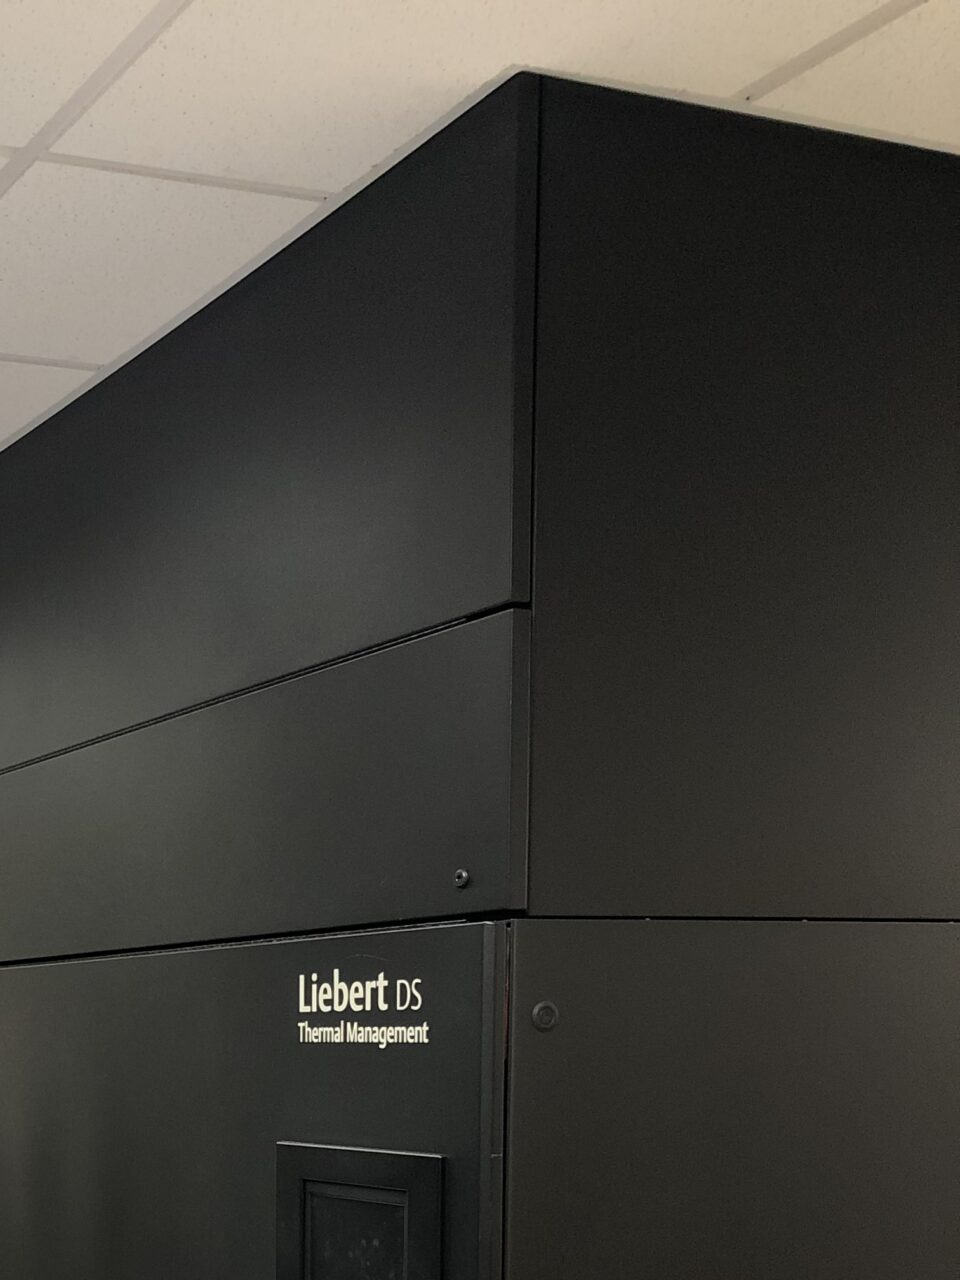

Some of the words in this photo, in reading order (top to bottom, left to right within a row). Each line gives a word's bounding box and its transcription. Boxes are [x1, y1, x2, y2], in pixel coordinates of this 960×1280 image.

[298, 968, 389, 1013] Liebert
[396, 978, 422, 1011] DS
[297, 1020, 344, 1043] Thermal
[346, 1021, 429, 1049] Management
